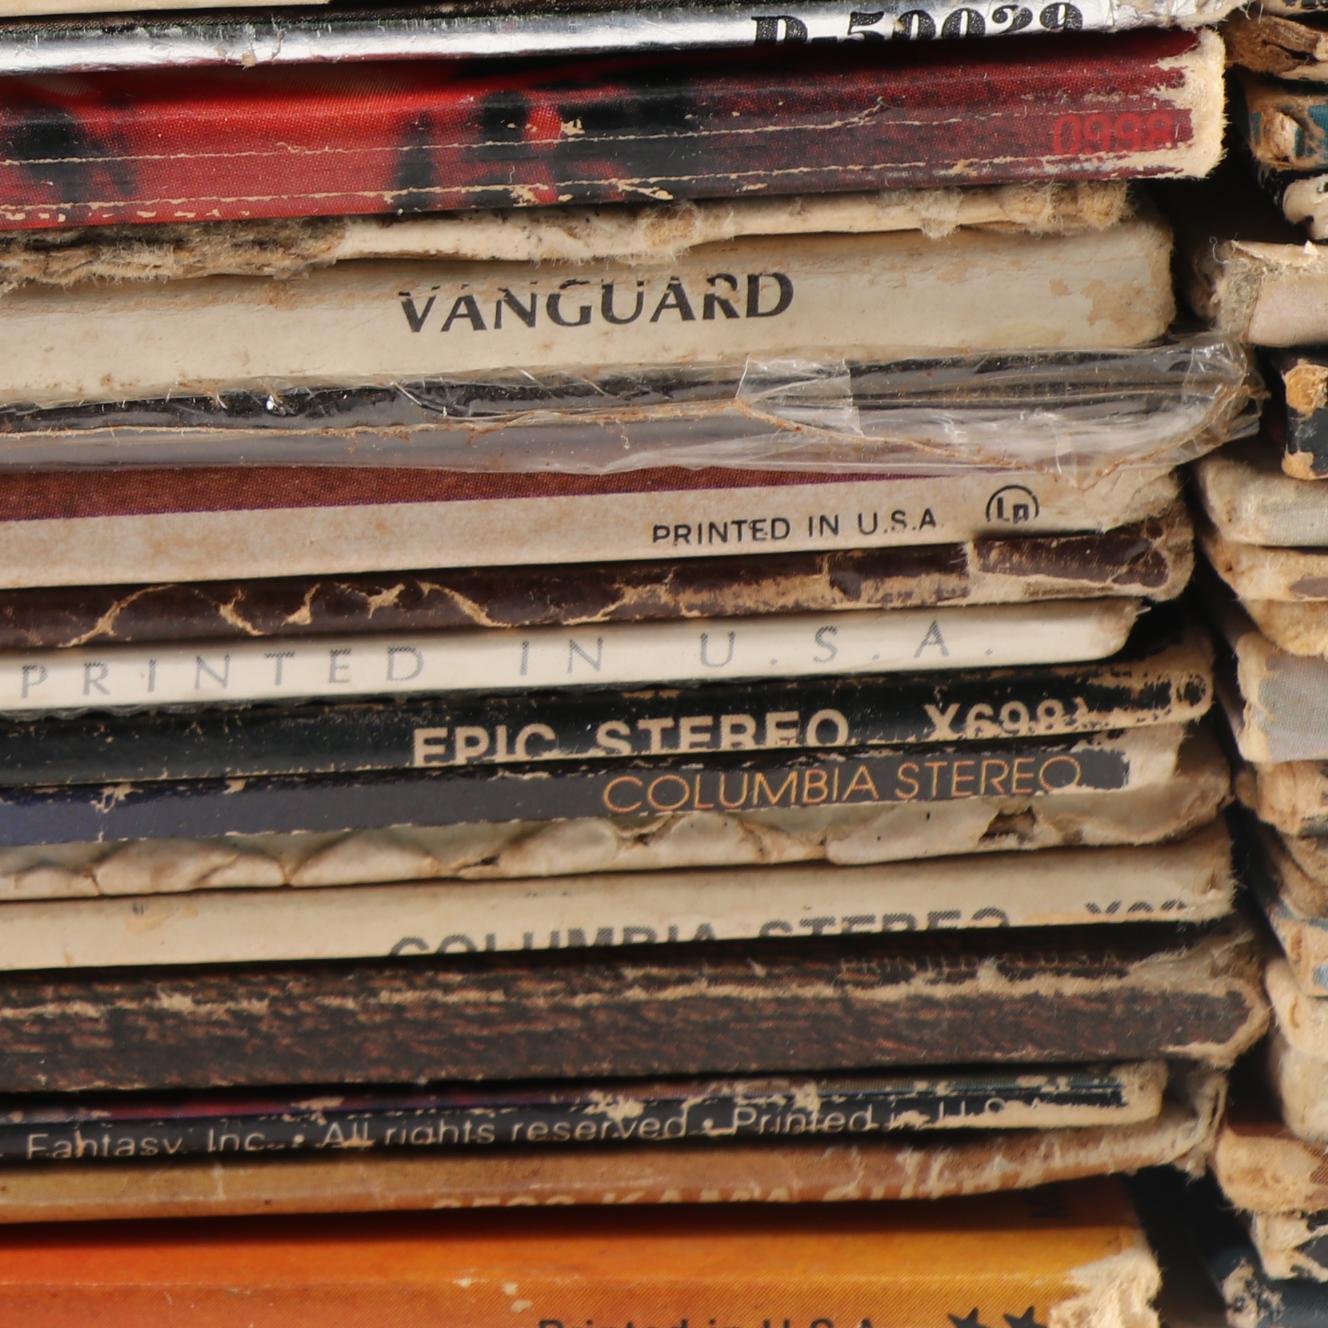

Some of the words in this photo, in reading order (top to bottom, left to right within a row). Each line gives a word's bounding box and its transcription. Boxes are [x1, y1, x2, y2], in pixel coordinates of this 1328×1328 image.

[397, 272, 795, 333] VANGUARD
[652, 517, 792, 546] PRINTED
[807, 514, 841, 537] IN
[21, 645, 426, 700] PRINTED
[519, 636, 605, 677] IN
[412, 722, 557, 767] EPIC
[595, 708, 850, 757] STEREO
[602, 764, 880, 813] COLUMBIA
[895, 755, 1082, 800] STEREO
[323, 1120, 371, 1147] All
[511, 1104, 689, 1143] reserved
[734, 1103, 874, 1137] Printed
